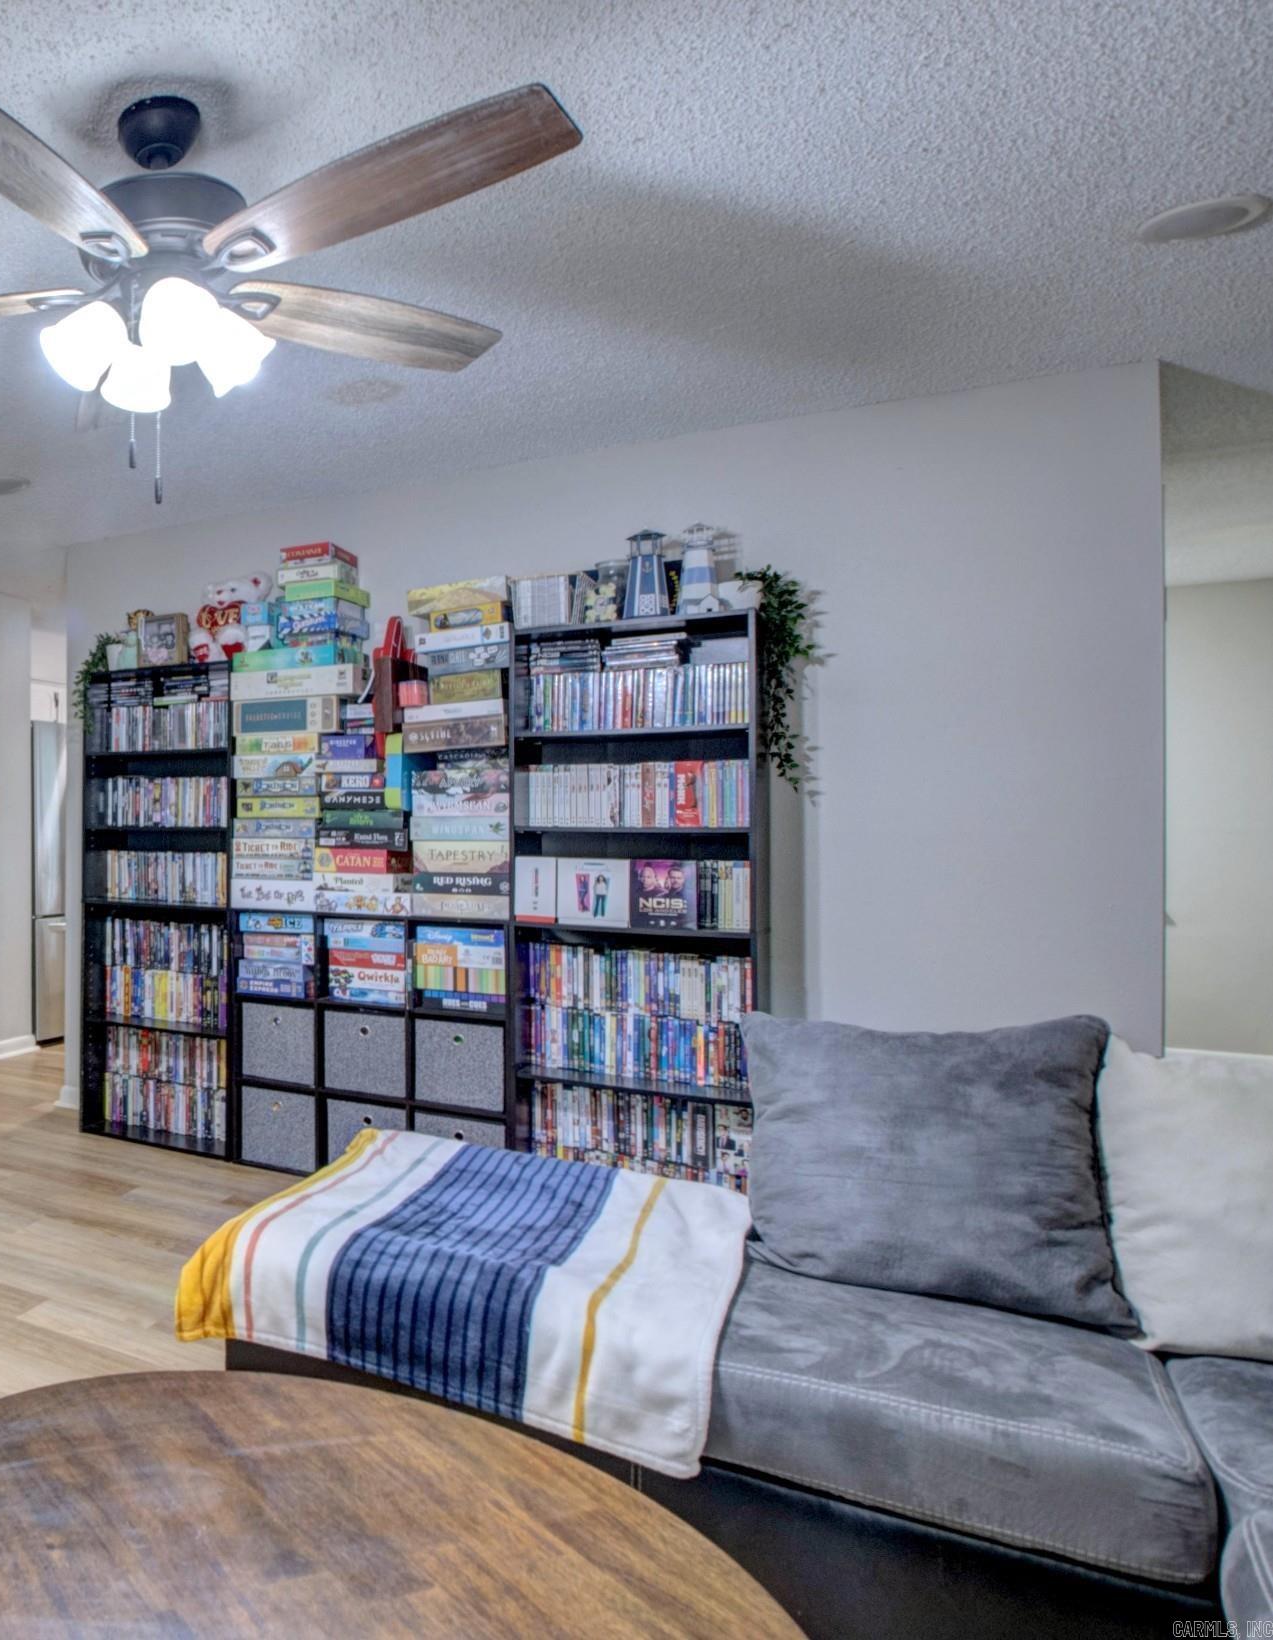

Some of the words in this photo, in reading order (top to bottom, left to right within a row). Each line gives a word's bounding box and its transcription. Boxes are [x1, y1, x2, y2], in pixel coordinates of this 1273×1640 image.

[341, 775, 370, 788] KERO
[324, 796, 381, 804] GANYMEDE
[335, 854, 371, 867] CATAN
[429, 848, 495, 861] TAPESTRY
[335, 876, 364, 885] Planted
[433, 875, 454, 887] RED
[455, 876, 493, 887] RISING
[358, 971, 400, 984] Qwirkle
